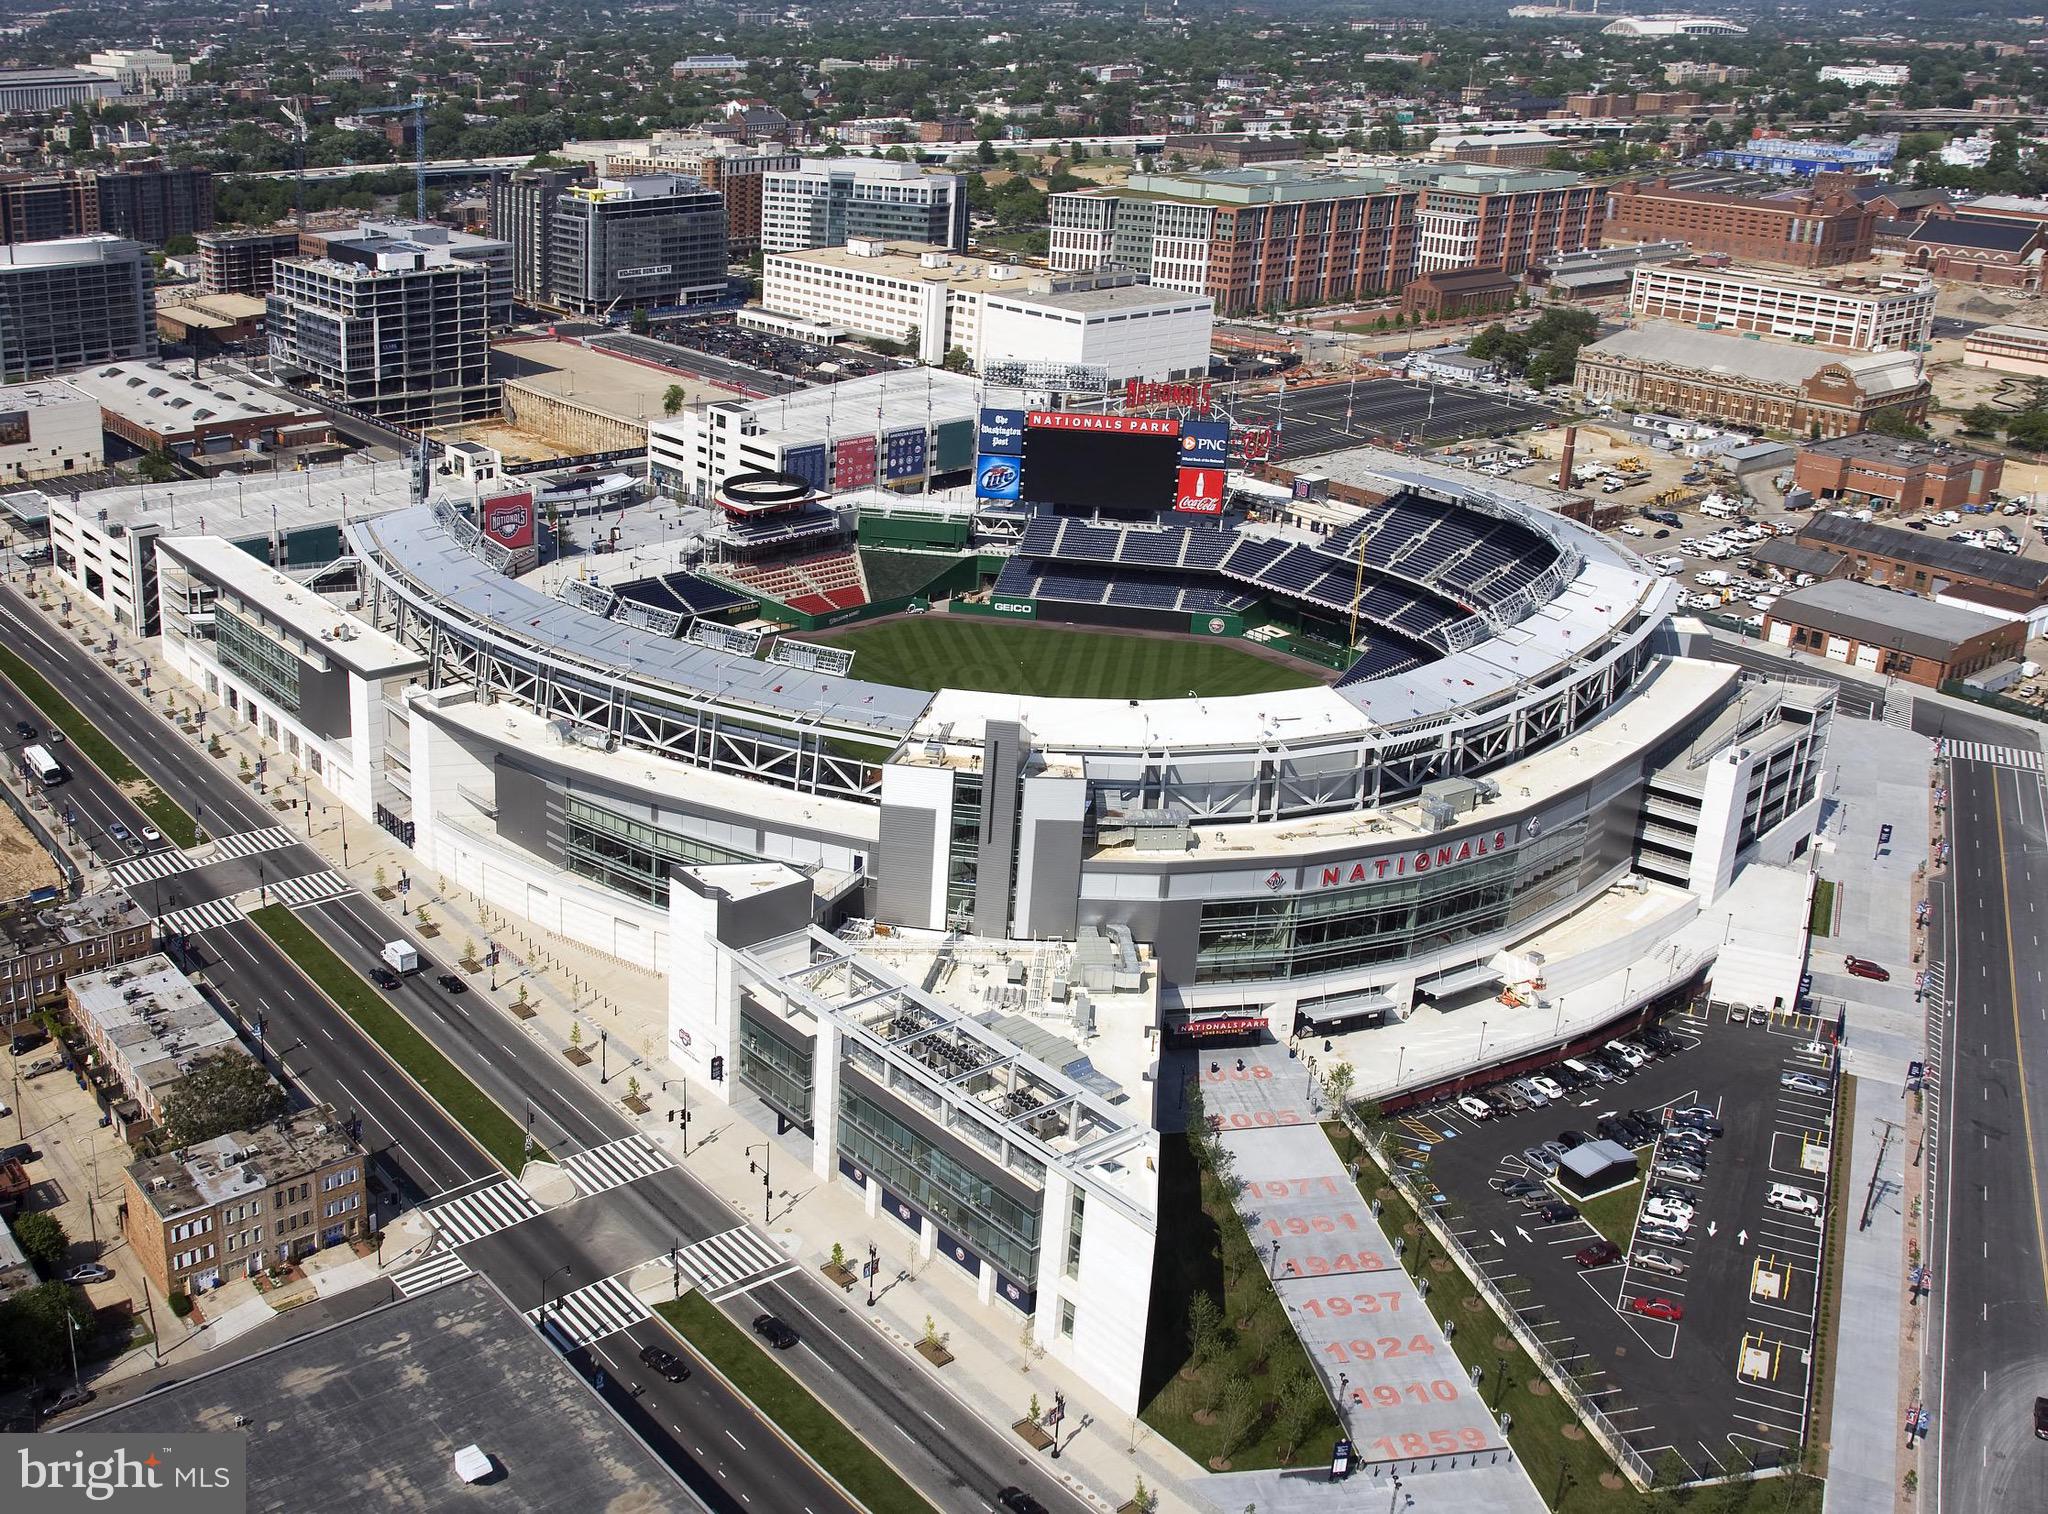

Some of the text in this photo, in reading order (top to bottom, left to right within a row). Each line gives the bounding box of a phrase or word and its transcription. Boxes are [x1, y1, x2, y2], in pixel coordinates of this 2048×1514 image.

[995, 415, 1008, 424] The
[1033, 415, 1170, 433] NATIONALS PARK
[981, 424, 1021, 436] Washington
[992, 437, 1008, 447] Post
[1198, 438, 1226, 451] PNC
[1295, 481, 1308, 498] 10
[491, 510, 526, 530] NATIONALS
[994, 603, 1032, 613] GEICO
[1322, 831, 1506, 887] NATIONALS
[1181, 1020, 1266, 1032] NATIONALS PARK
[1190, 1065, 1274, 1084] 008
[1246, 1176, 1338, 1199] 1971
[1263, 1213, 1357, 1238] 1961
[1281, 1252, 1384, 1276] 1948
[1302, 1292, 1402, 1318] 1937
[1324, 1334, 1435, 1363] 1924
[1351, 1379, 1459, 1409] 1910
[1371, 1427, 1488, 1458] 1859
